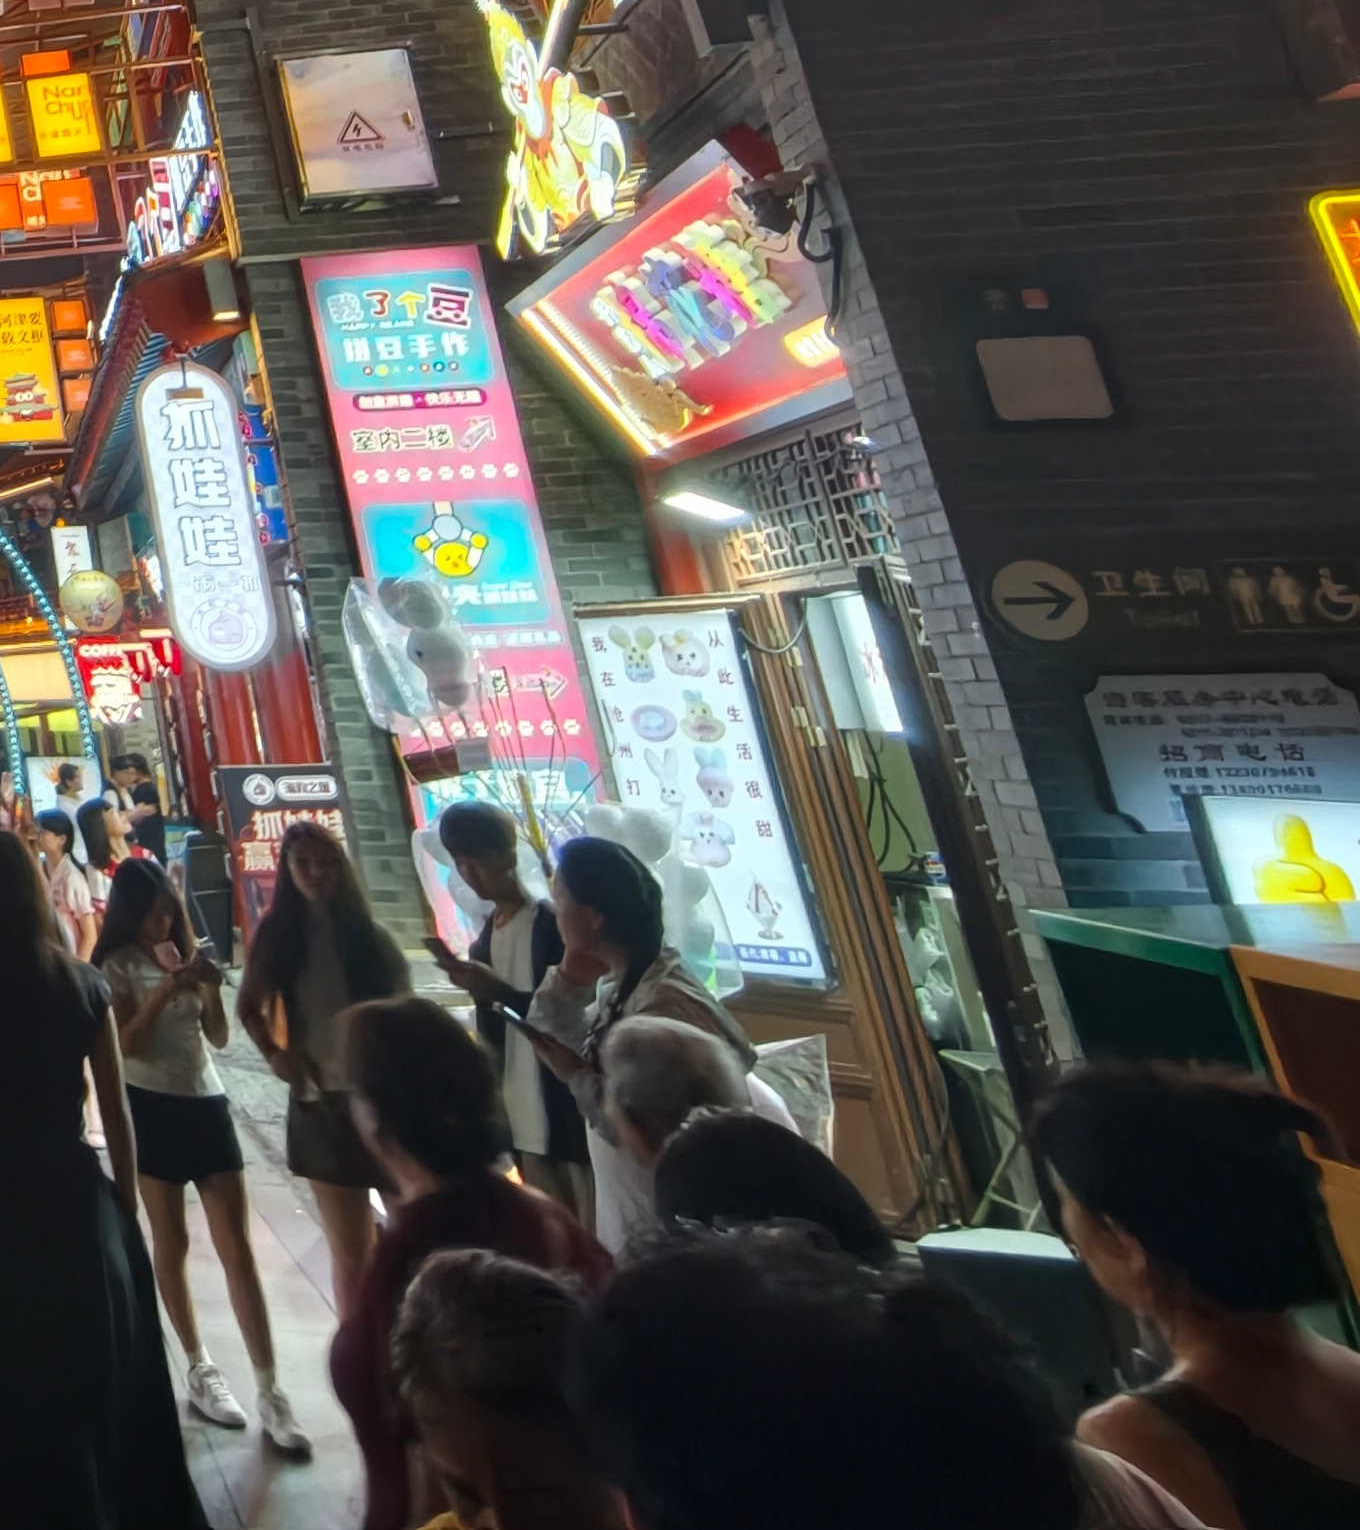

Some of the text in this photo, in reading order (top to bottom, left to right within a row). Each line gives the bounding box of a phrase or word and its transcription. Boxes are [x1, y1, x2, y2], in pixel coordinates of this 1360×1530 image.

[160, 400, 242, 567] 抓娃娃
[351, 425, 453, 452] 室内二楼
